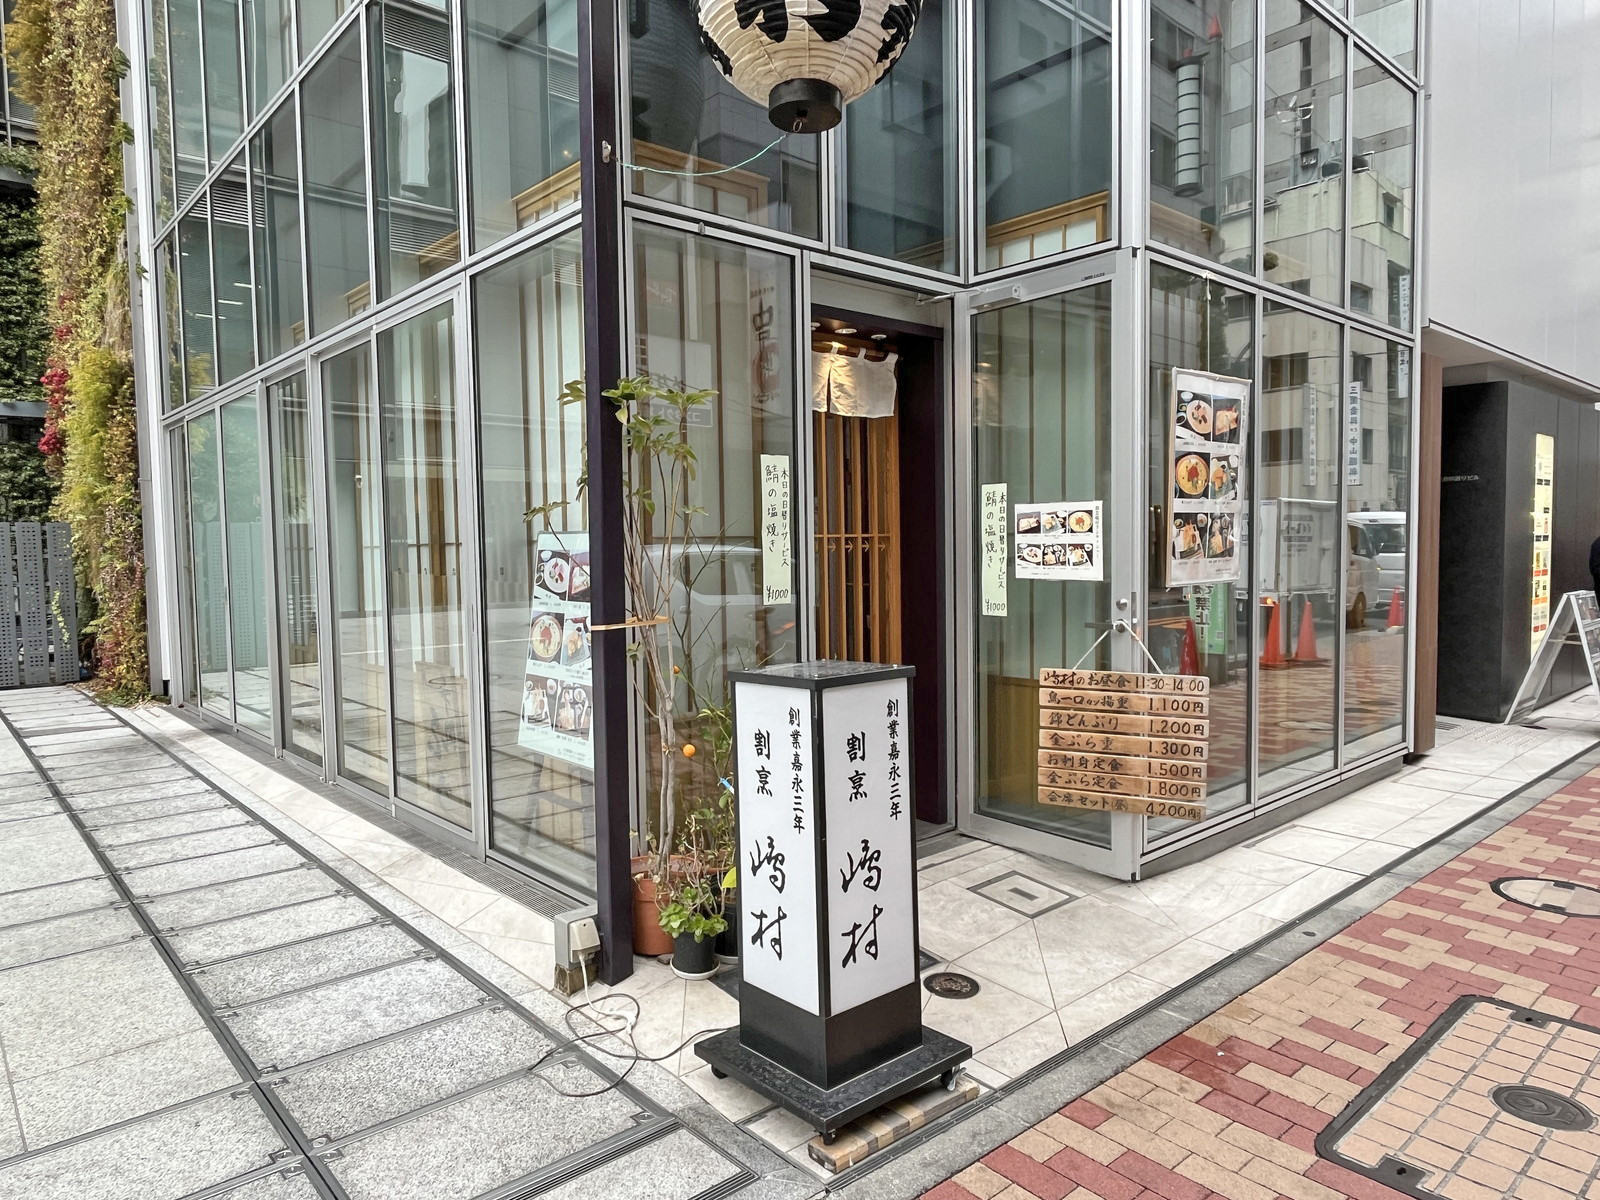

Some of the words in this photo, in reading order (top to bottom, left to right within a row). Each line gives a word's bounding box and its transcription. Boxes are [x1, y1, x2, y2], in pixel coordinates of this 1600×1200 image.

[754, 729, 773, 797] 割烹
[788, 706, 805, 835] 創業嘉永三年
[846, 732, 867, 803] 割烹
[886, 698, 903, 821] 創業嘉永三年
[1047, 756, 1123, 772] お刺身定食
